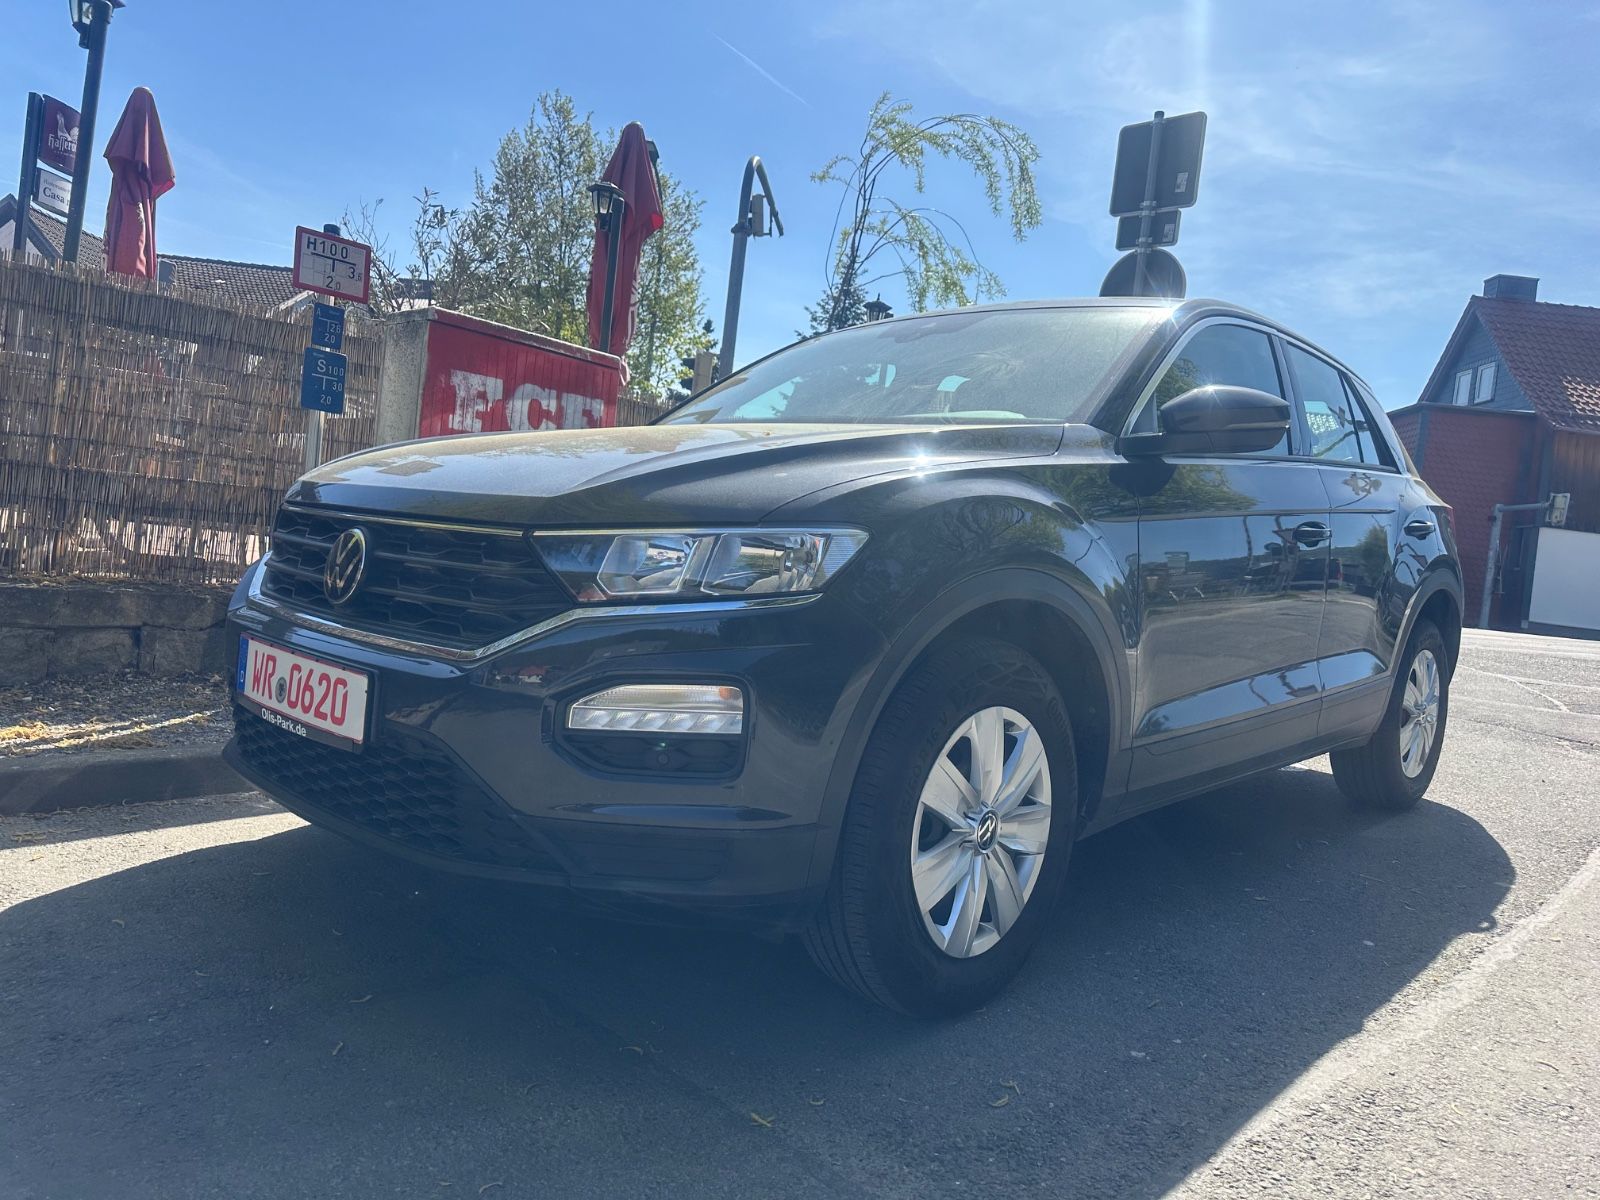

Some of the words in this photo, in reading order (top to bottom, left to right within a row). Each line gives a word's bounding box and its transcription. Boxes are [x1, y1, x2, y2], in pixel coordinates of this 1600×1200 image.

[43, 186, 65, 203] Casa
[306, 236, 348, 260] H100
[252, 650, 277, 700] WR
[287, 663, 348, 726] 0620
[261, 708, 307, 737] Olis-Park.de
